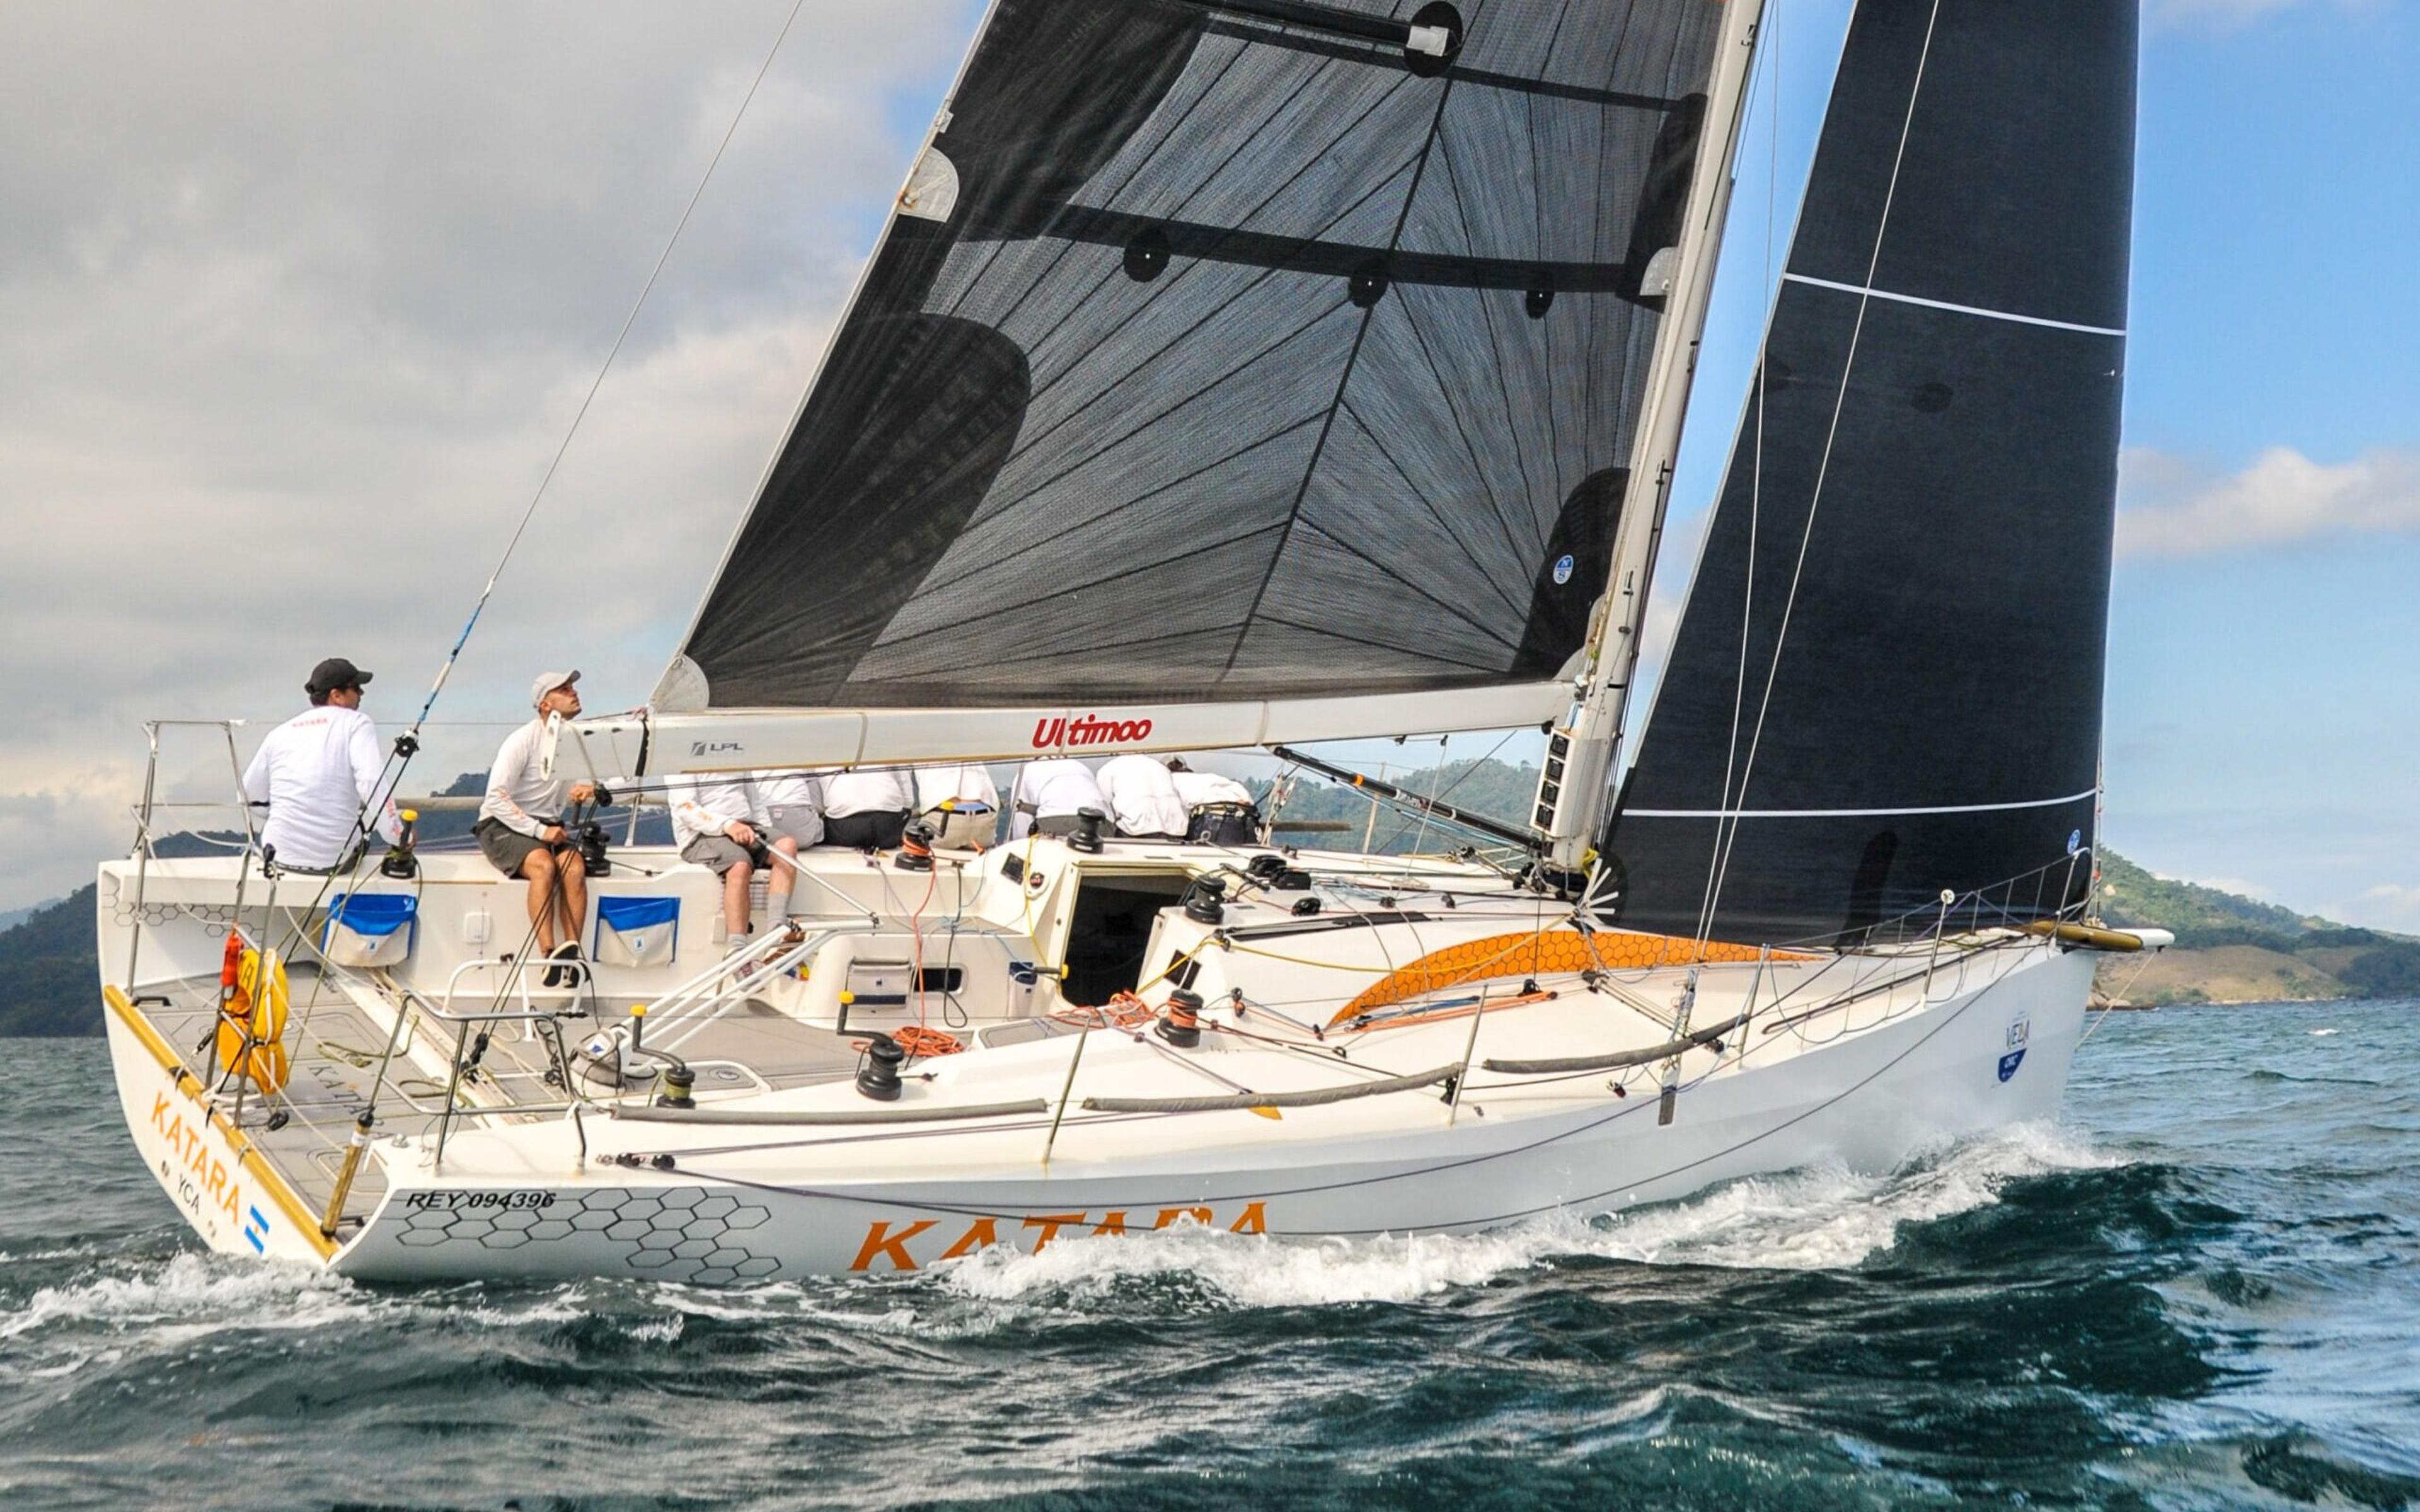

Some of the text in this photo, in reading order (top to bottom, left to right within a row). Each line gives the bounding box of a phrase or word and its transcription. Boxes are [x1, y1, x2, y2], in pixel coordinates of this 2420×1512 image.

[1032, 714, 1153, 748] Ultimoo
[151, 1091, 241, 1225] KATARA
[178, 1173, 200, 1215] YCA
[406, 1193, 556, 1208] REY 094396
